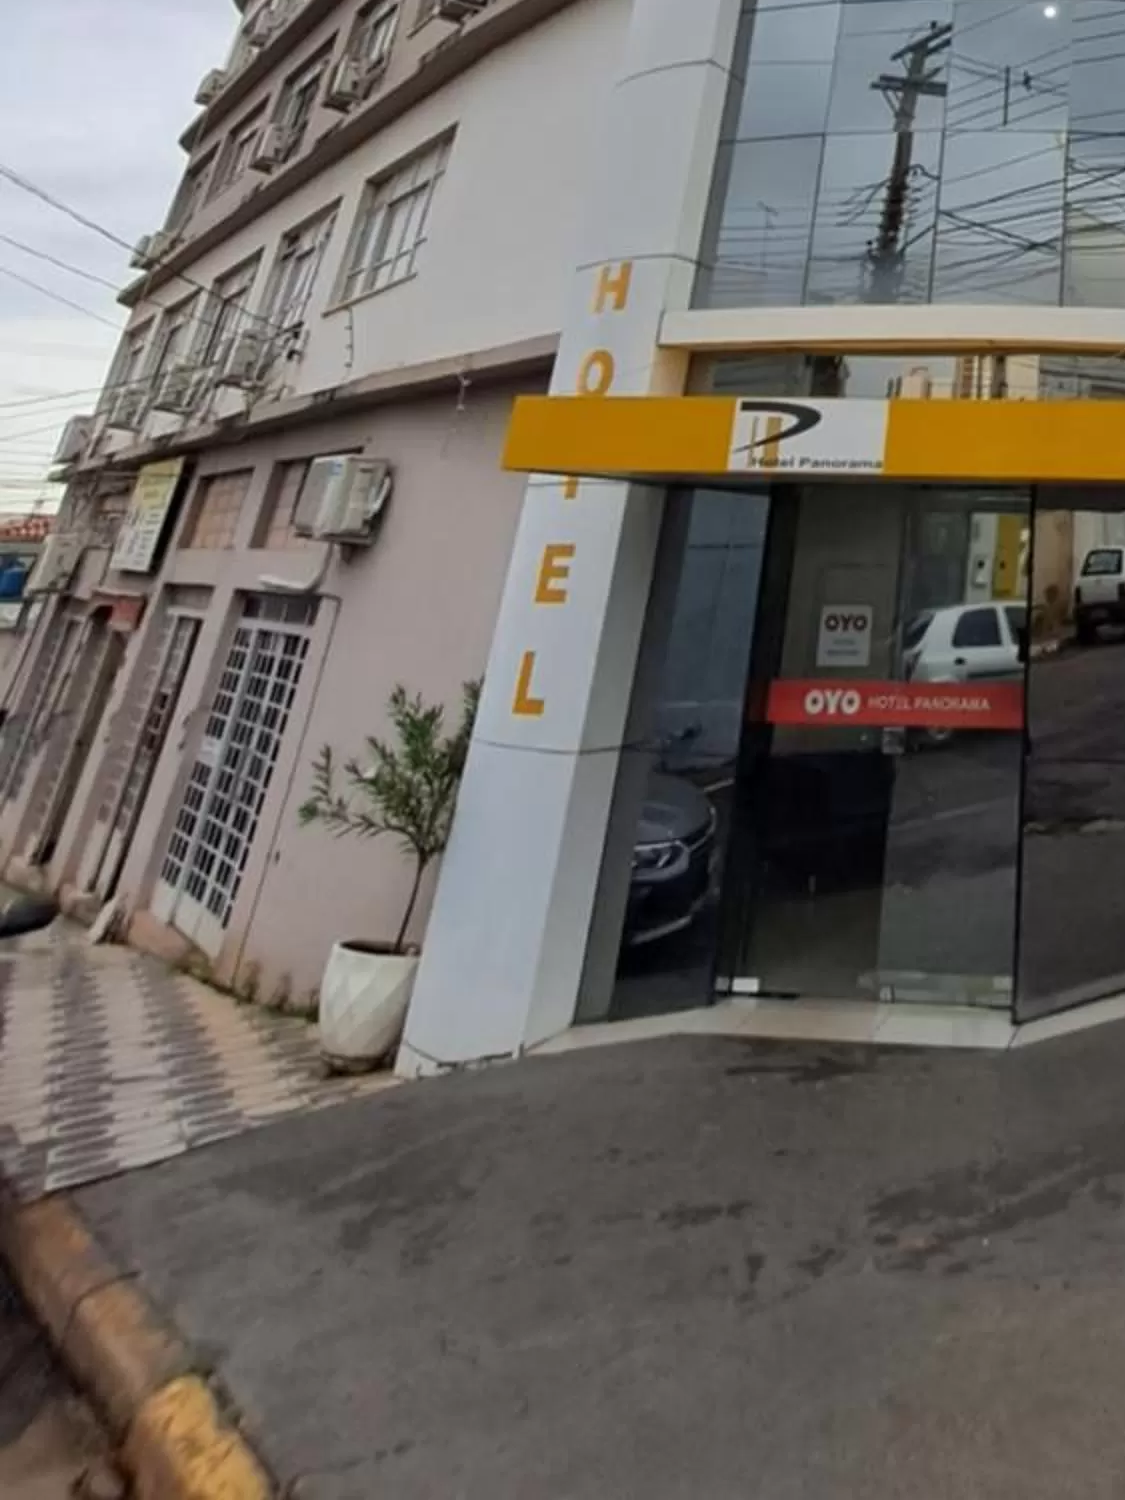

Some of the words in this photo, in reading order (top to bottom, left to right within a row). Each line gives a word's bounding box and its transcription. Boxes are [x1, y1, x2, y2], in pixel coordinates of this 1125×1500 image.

[749, 456, 795, 469] Hotel
[799, 456, 883, 469] Panorama
[824, 612, 868, 632] OYO
[804, 688, 861, 715] OYO
[867, 695, 911, 711] HOTEL
[913, 695, 991, 711] PANORAMA
